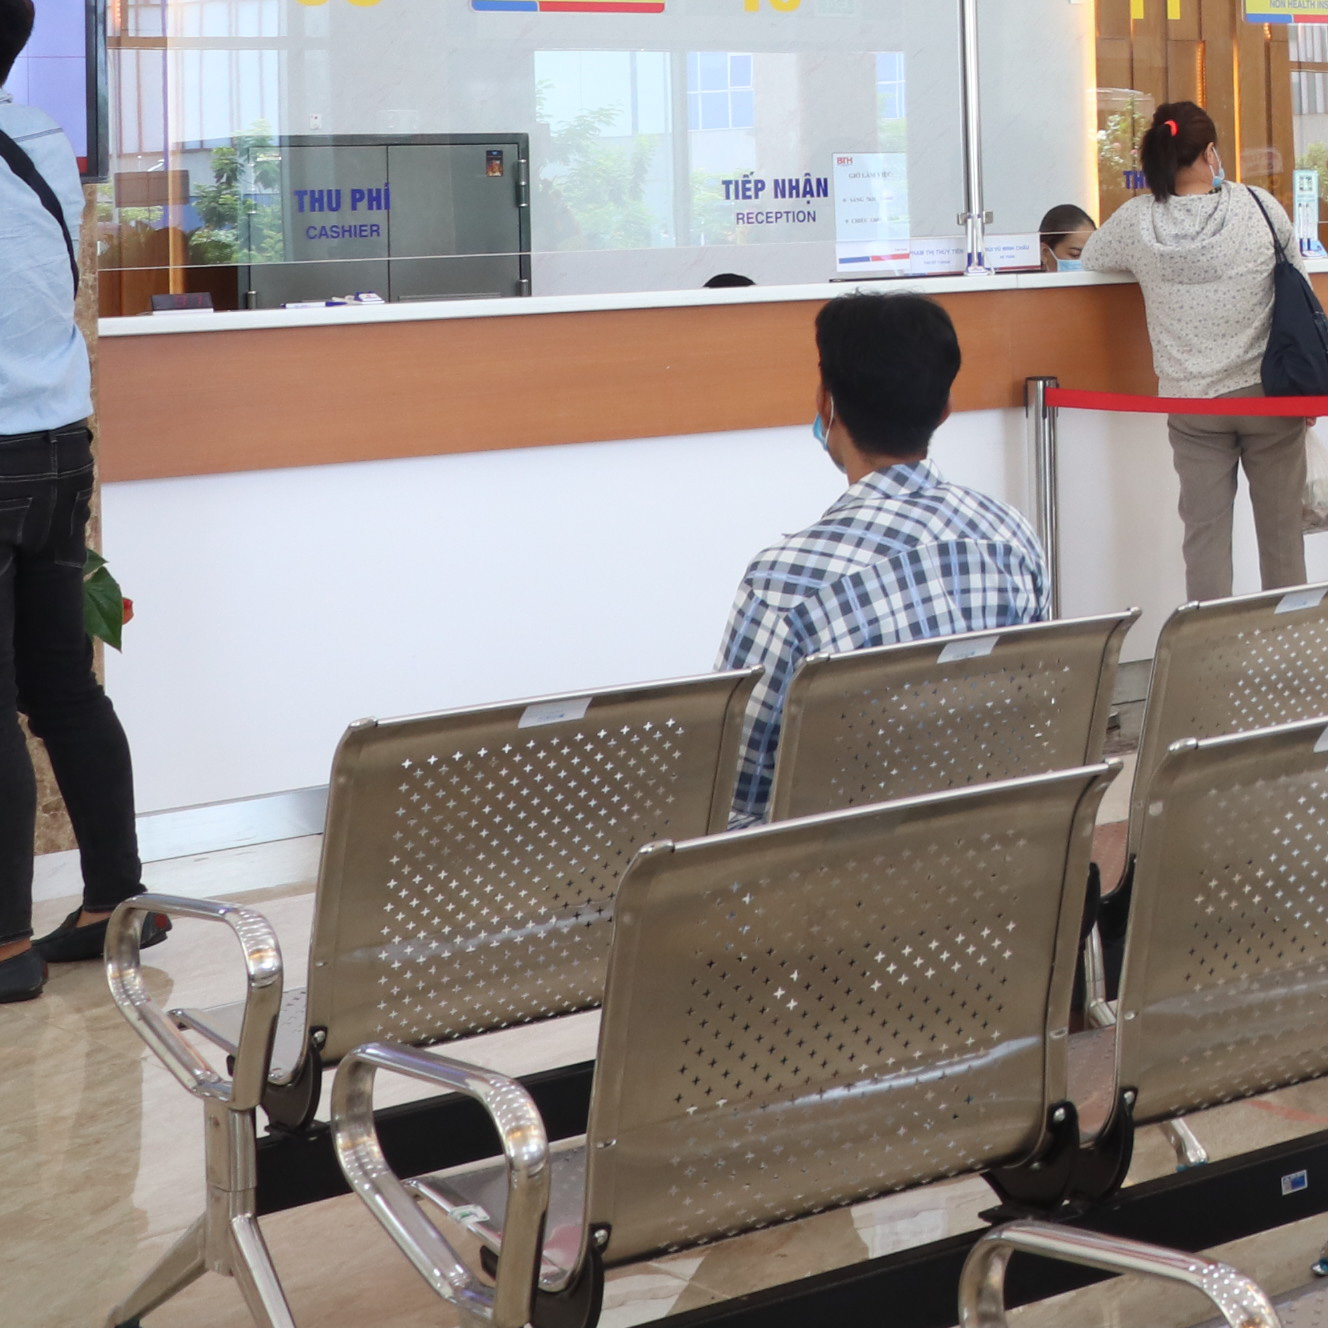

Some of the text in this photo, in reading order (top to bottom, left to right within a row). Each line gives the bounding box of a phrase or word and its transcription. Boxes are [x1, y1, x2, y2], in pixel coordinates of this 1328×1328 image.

[1269, 0, 1286, 9] NON
[1287, 0, 1315, 9] HEALTH
[721, 172, 829, 204] TIẾP NHẬN
[1123, 170, 1148, 189] TH
[294, 182, 391, 212] THU PHÍ
[736, 210, 817, 225] RECEPTION
[306, 224, 381, 240] CASHIER
